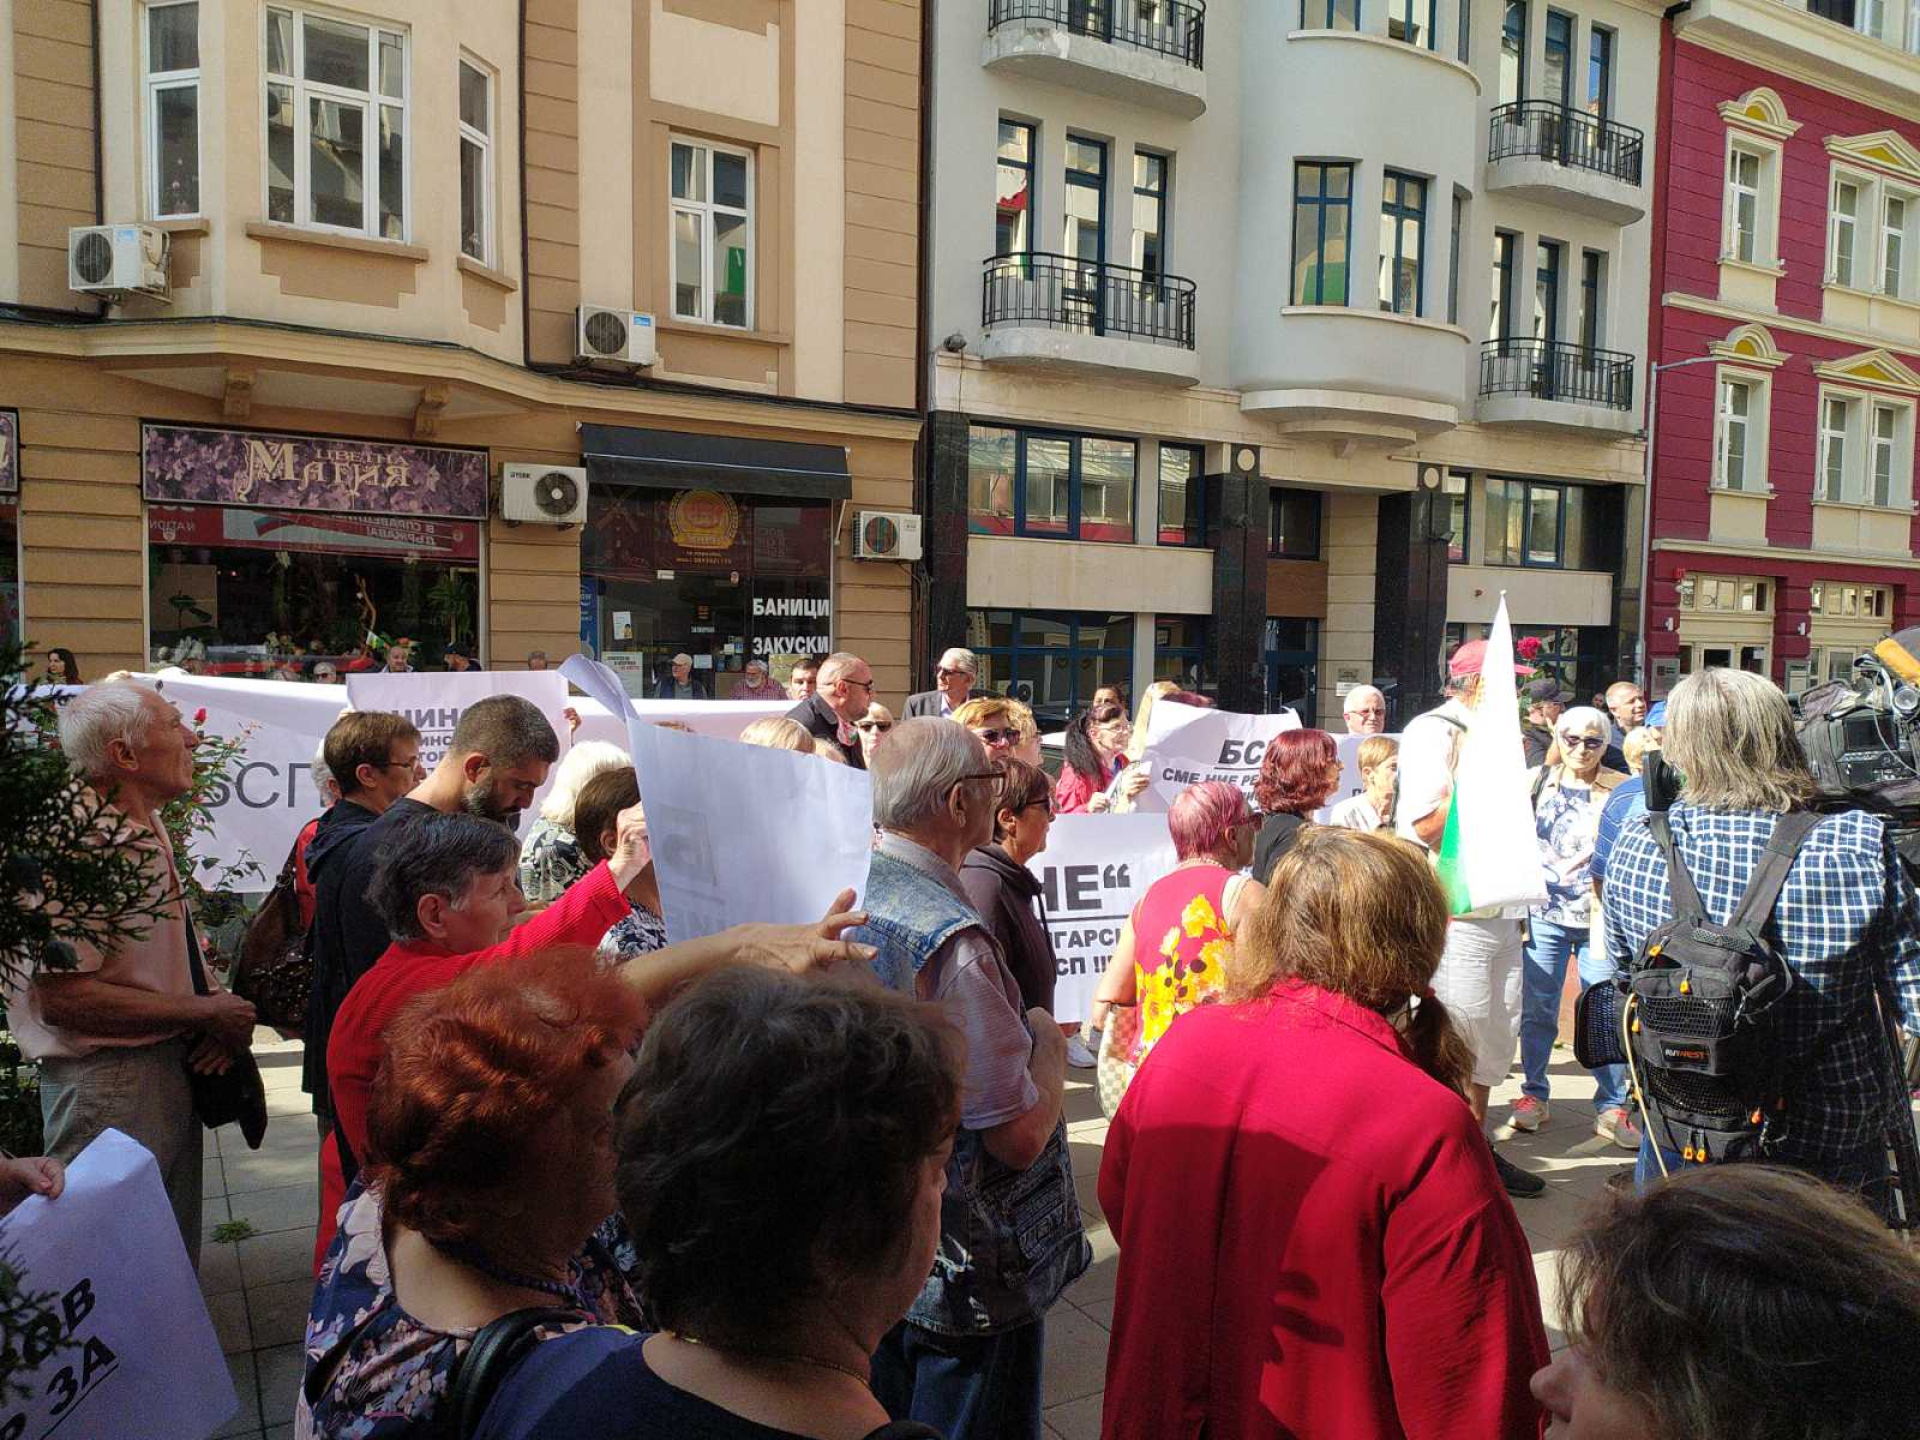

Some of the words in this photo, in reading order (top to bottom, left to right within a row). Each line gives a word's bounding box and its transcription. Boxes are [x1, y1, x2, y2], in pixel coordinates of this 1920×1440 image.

[315, 448, 408, 466] ЦВЕТНА
[753, 598, 829, 619] БАНИЦИ
[753, 636, 829, 655] ЗАКУСКИ
[1162, 767, 1200, 784] СМЕ
